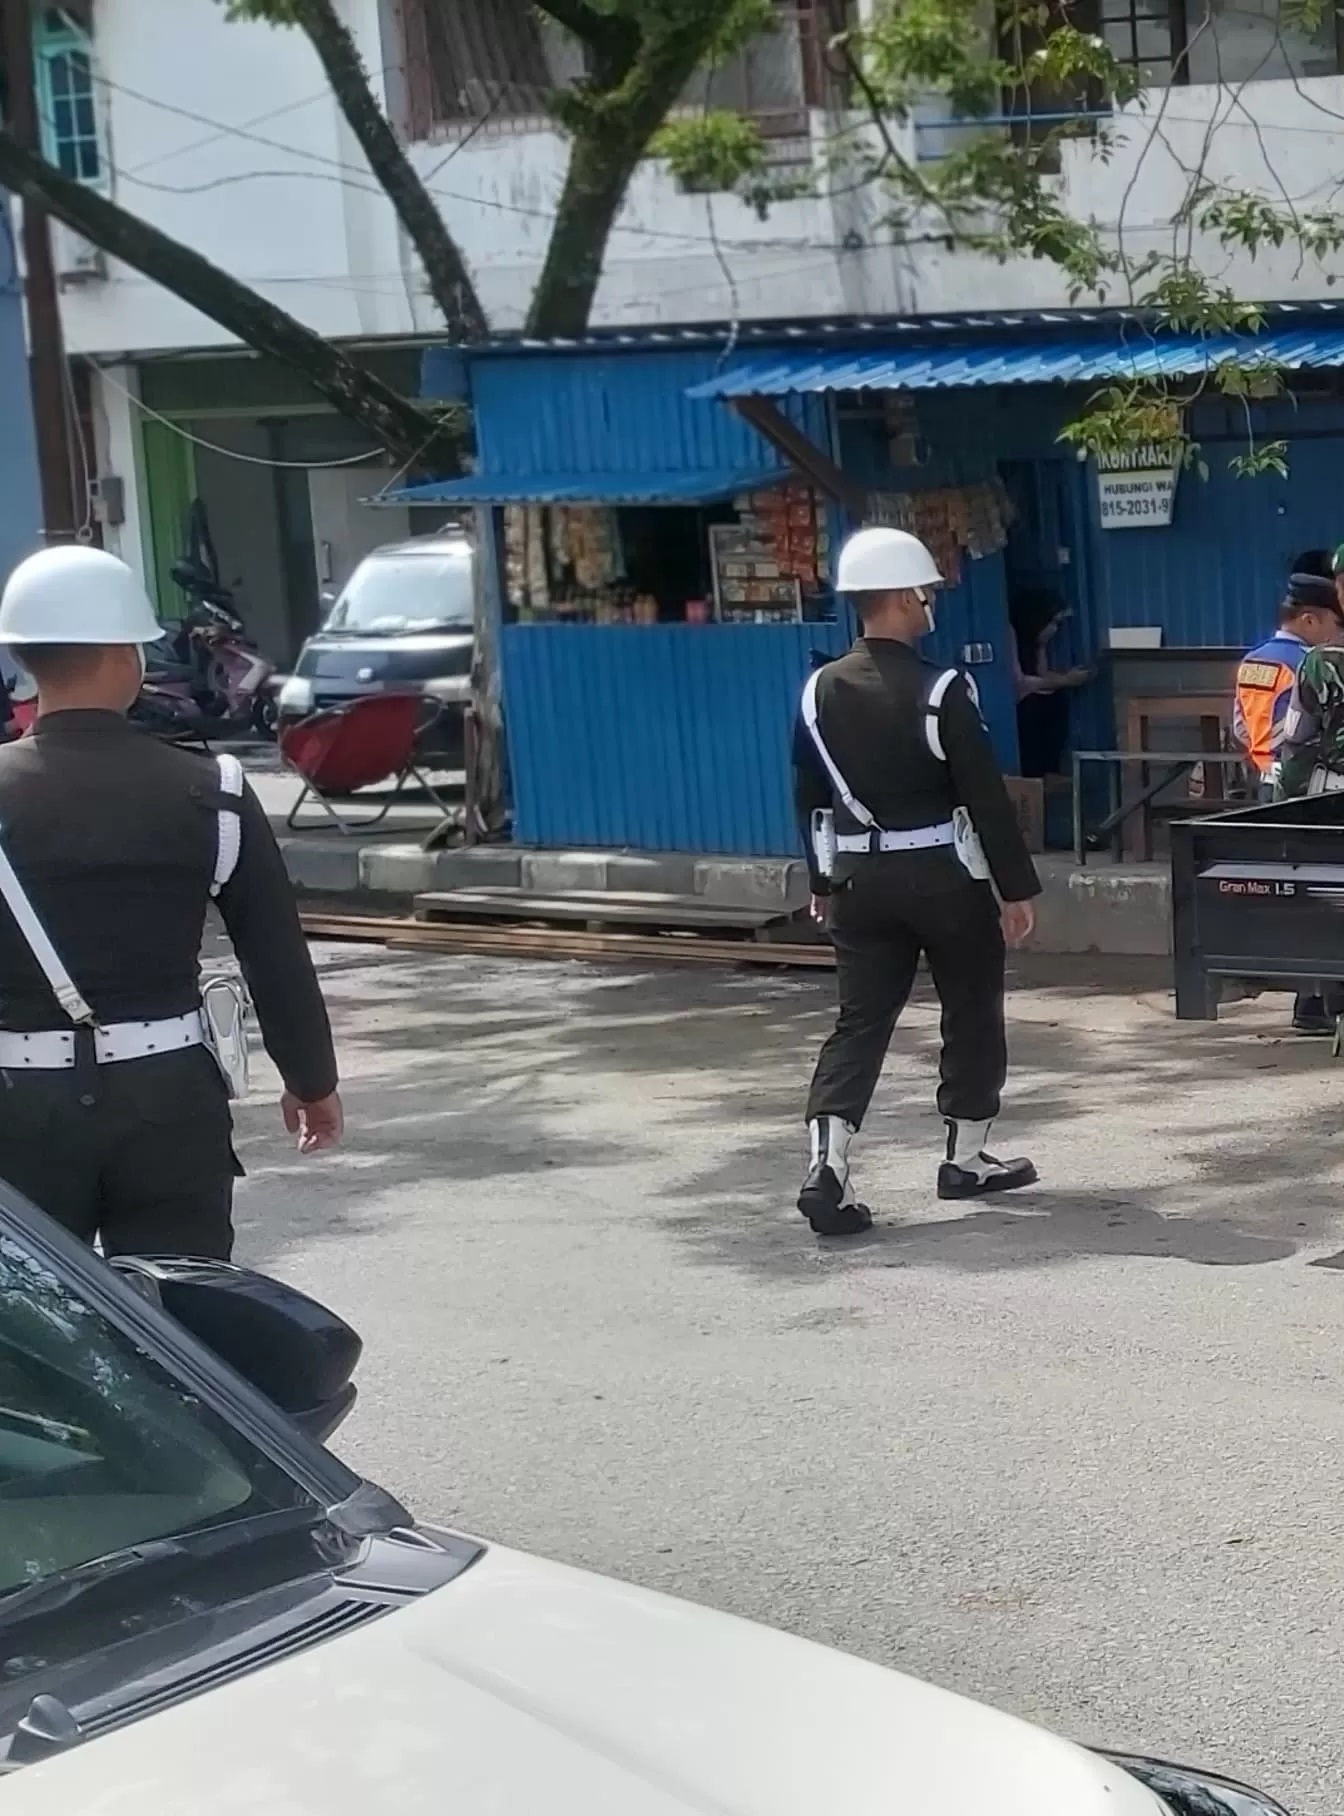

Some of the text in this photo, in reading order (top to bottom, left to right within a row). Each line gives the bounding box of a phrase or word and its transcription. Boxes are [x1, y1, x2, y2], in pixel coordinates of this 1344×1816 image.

[1104, 481, 1153, 495] HUBUNGI
[1218, 880, 1246, 895] Gran
[1275, 882, 1297, 896] 1.5
